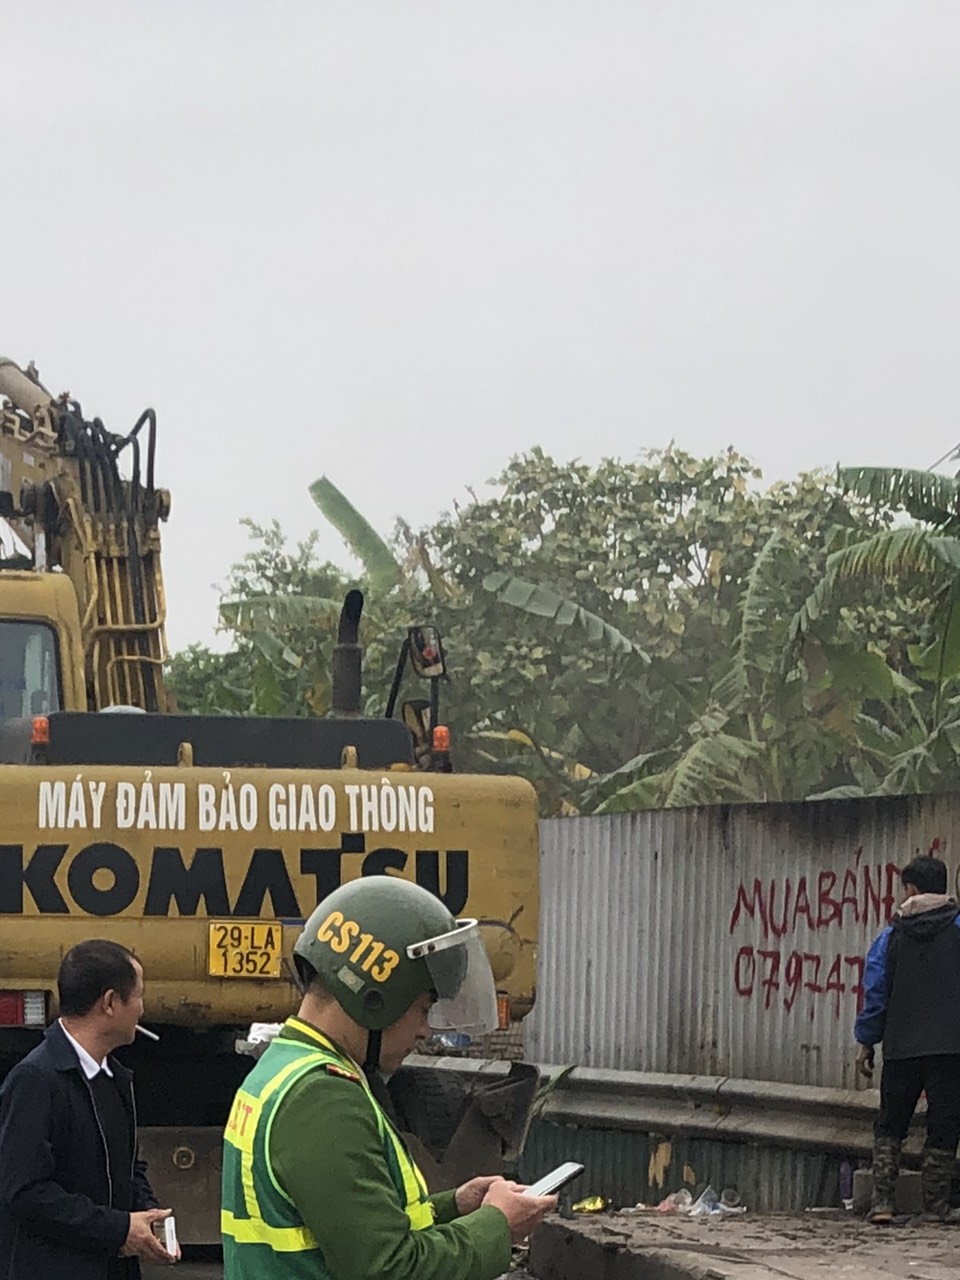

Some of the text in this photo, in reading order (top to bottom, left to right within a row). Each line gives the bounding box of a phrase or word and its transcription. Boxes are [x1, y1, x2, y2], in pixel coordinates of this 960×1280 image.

[38, 770, 434, 833] MÁY ĐẢM BẢO GIAO THÔNG
[221, 951, 271, 975] 1352
[734, 946, 865, 1022] 079747
